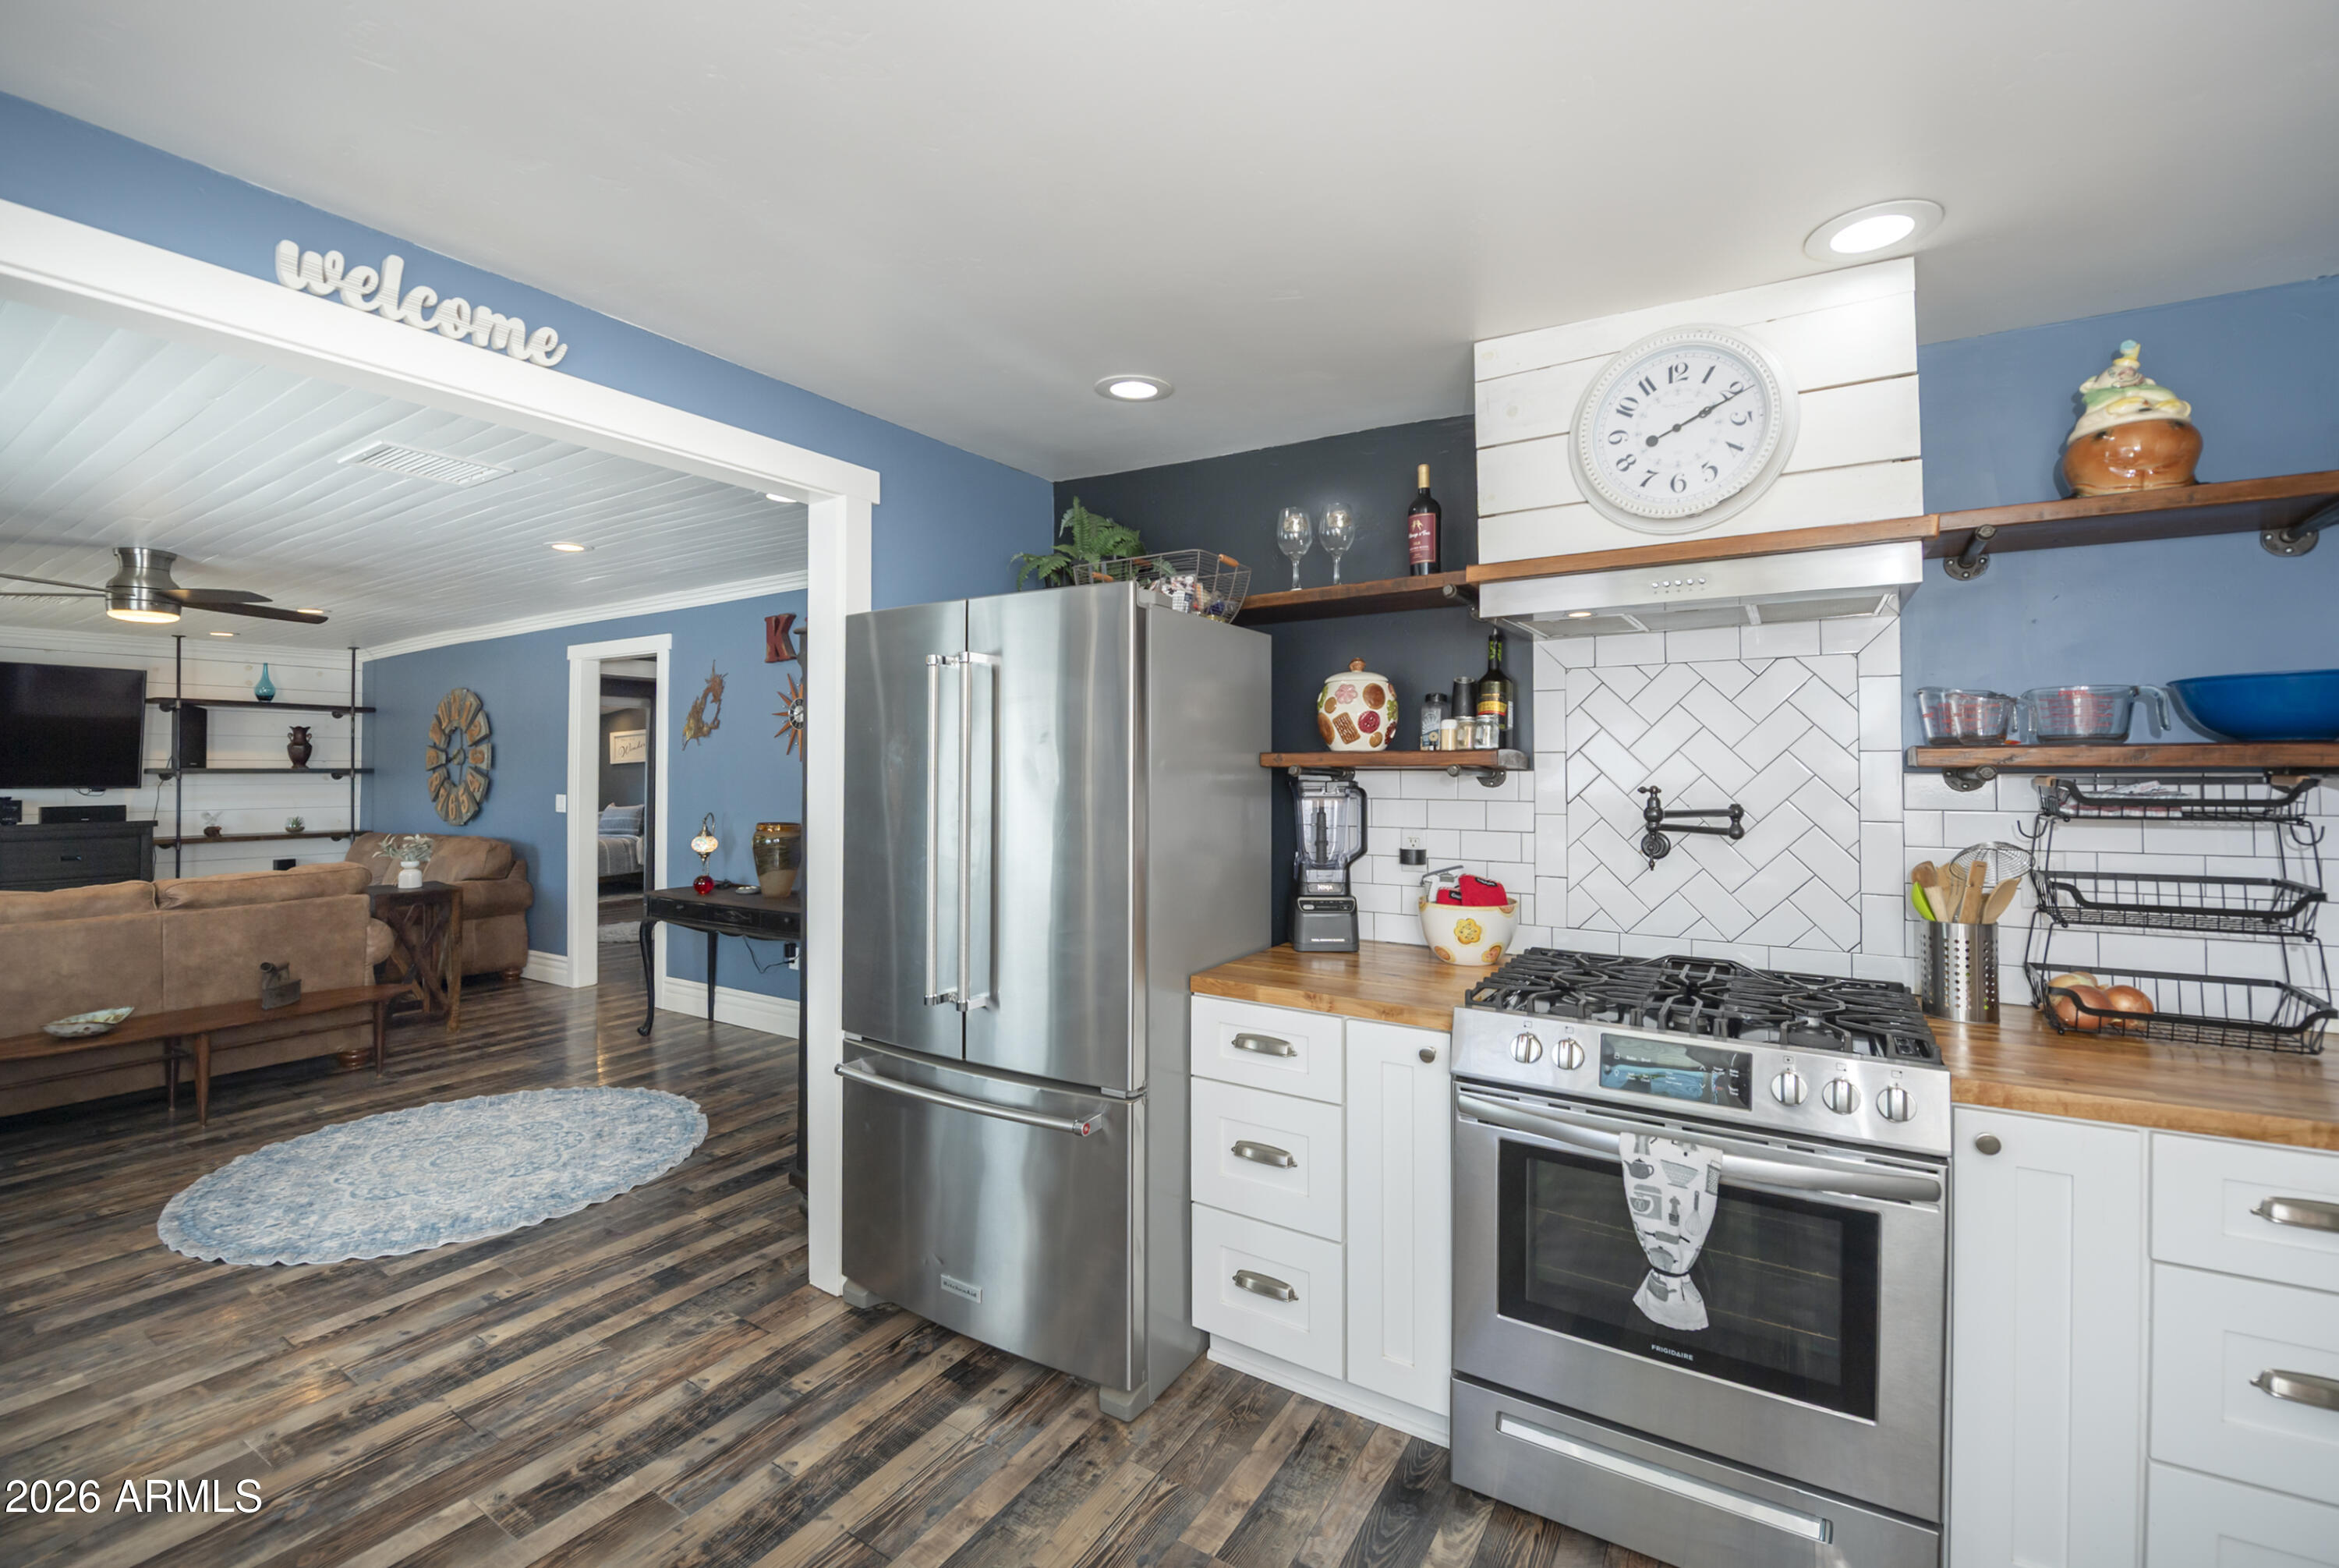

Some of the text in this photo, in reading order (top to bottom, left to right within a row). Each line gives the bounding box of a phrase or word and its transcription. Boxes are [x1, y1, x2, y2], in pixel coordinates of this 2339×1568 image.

[275, 239, 568, 367] welcome
[1667, 362, 1689, 384] 12
[1701, 365, 1716, 384] 1
[1638, 376, 1658, 396] 11
[1721, 381, 1745, 401] 2
[1615, 397, 1639, 418] 10
[1729, 411, 1753, 427] 3
[1608, 430, 1630, 445] 9
[1725, 441, 1745, 458] 4
[1615, 454, 1637, 473] 8
[1701, 462, 1719, 483] 5
[1639, 469, 1660, 488] 7
[1670, 473, 1687, 494] 6
[764, 612, 797, 664] K
[448, 794, 457, 820] 6
[458, 788, 469, 813] 5
[1651, 1343, 1694, 1361] FRIGIDAIRE
